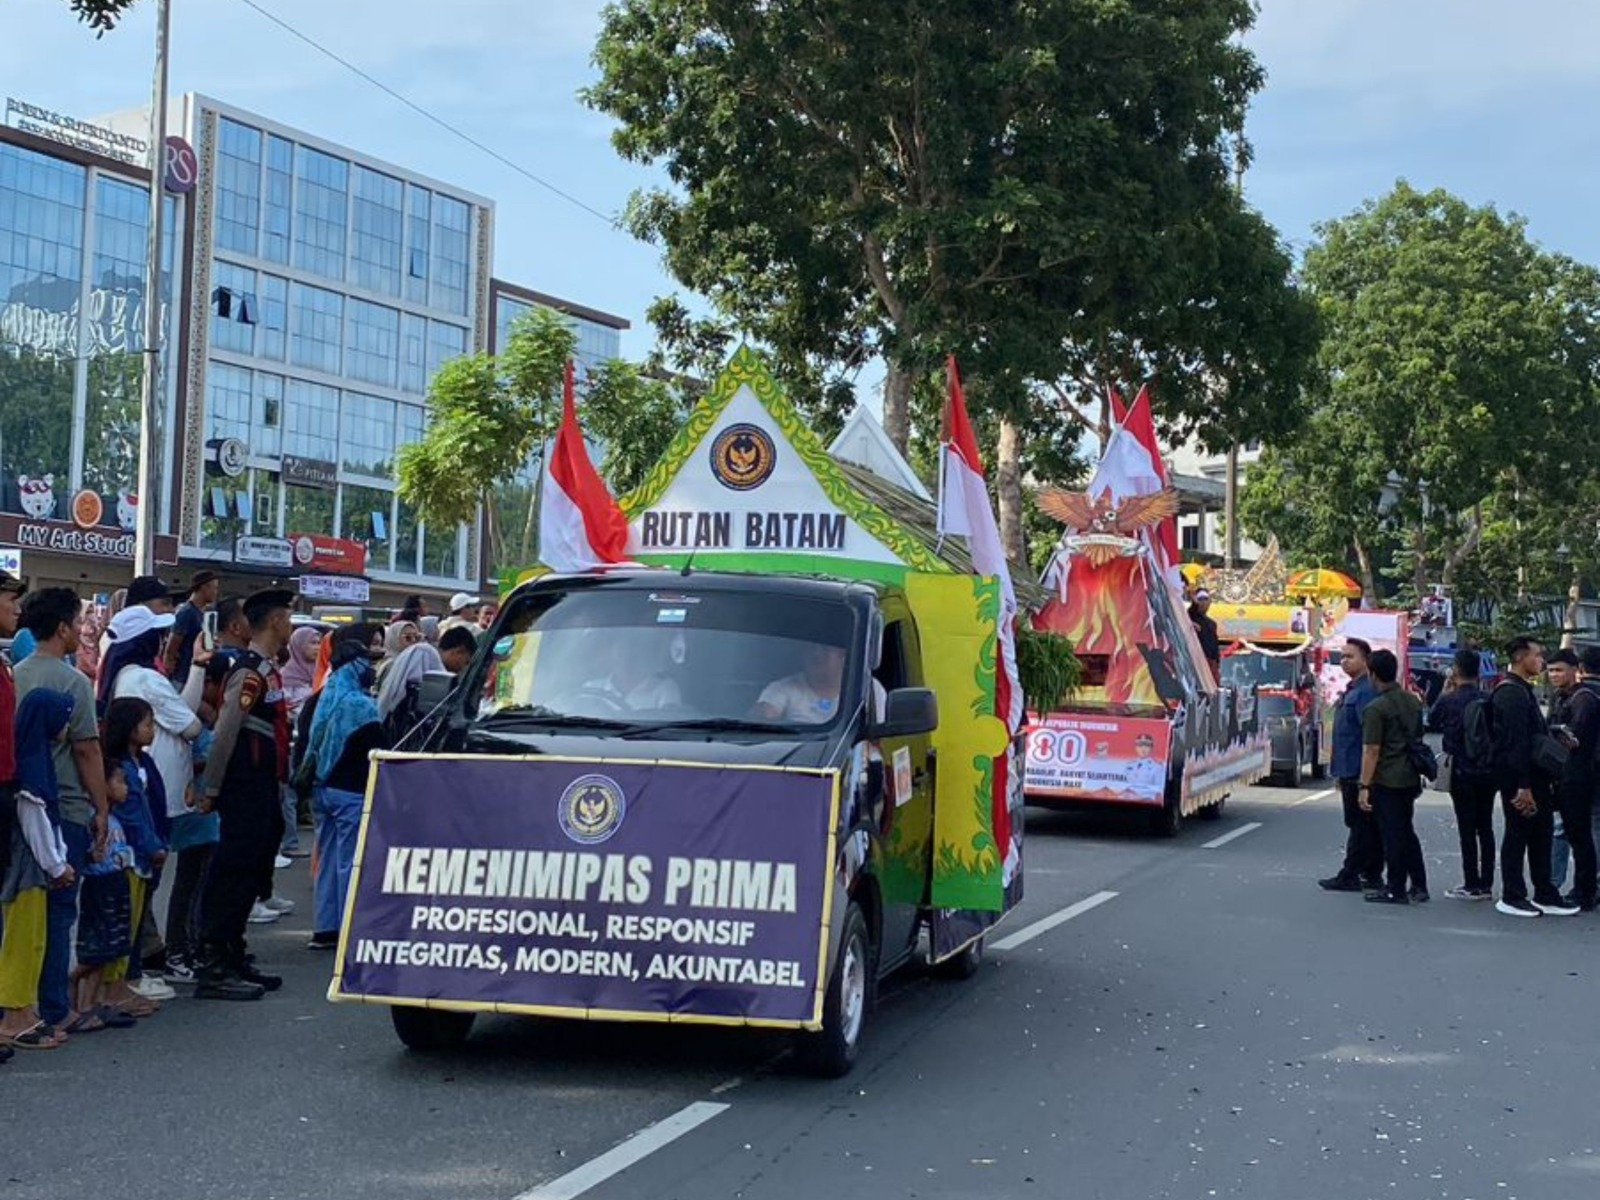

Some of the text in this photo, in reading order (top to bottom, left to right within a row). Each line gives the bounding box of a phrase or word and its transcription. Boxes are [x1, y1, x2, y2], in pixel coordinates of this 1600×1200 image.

[18, 523, 137, 557] MY Art Studi
[641, 511, 847, 549] RUTAN BATAM
[1028, 729, 1085, 765] 80
[381, 846, 798, 913] KEMENIMIPAS PRIMA
[411, 906, 756, 946] PROFESIONAL, RESPONSIF
[355, 939, 806, 988] INTEGRITAS, MODERN, AKUNTABEL
